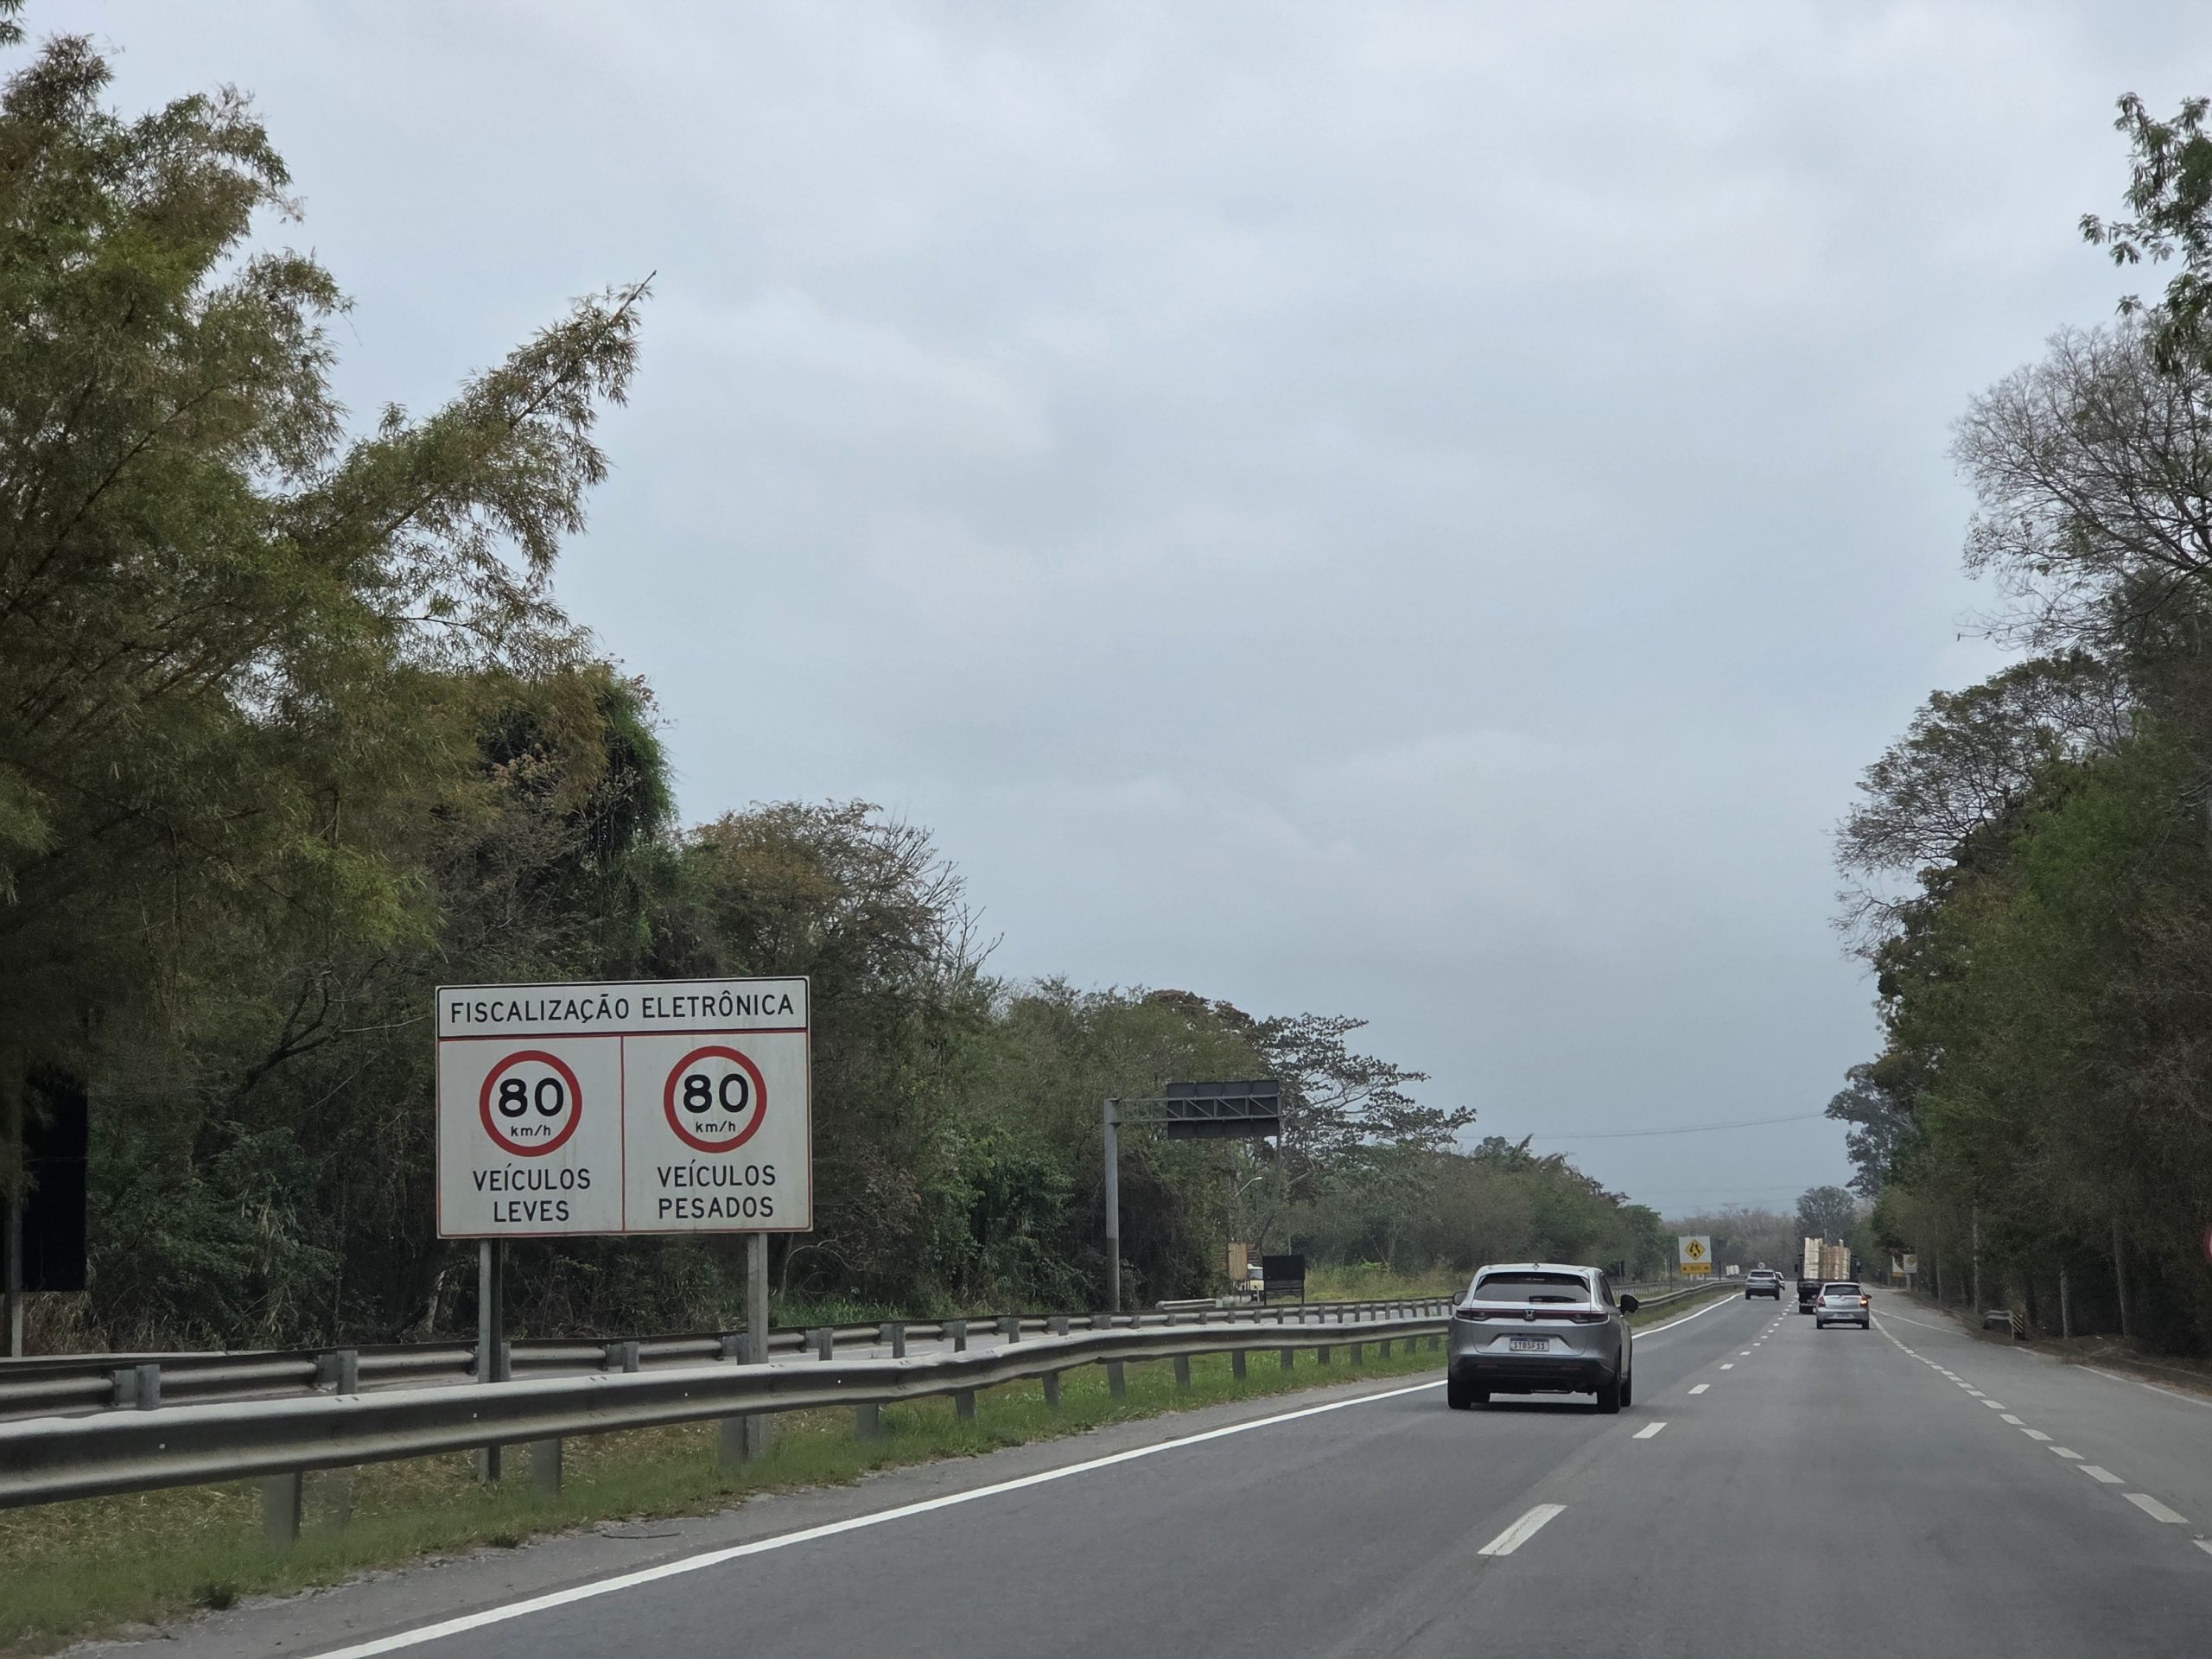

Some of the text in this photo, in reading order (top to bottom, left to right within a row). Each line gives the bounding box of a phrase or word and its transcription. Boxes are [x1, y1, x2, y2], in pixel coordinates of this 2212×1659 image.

[451, 990, 794, 1024] FISCALIZAÇÃO ELETRÔNICA
[498, 1077, 564, 1117] 80
[683, 1073, 749, 1114] 80
[510, 1124, 551, 1137] km/h
[696, 1121, 736, 1133] km/h
[473, 1163, 591, 1192] VEÍCULOS
[657, 1159, 776, 1188] VEÍCULOS
[493, 1200, 569, 1223] LEVES
[658, 1196, 773, 1219] PESADOS
